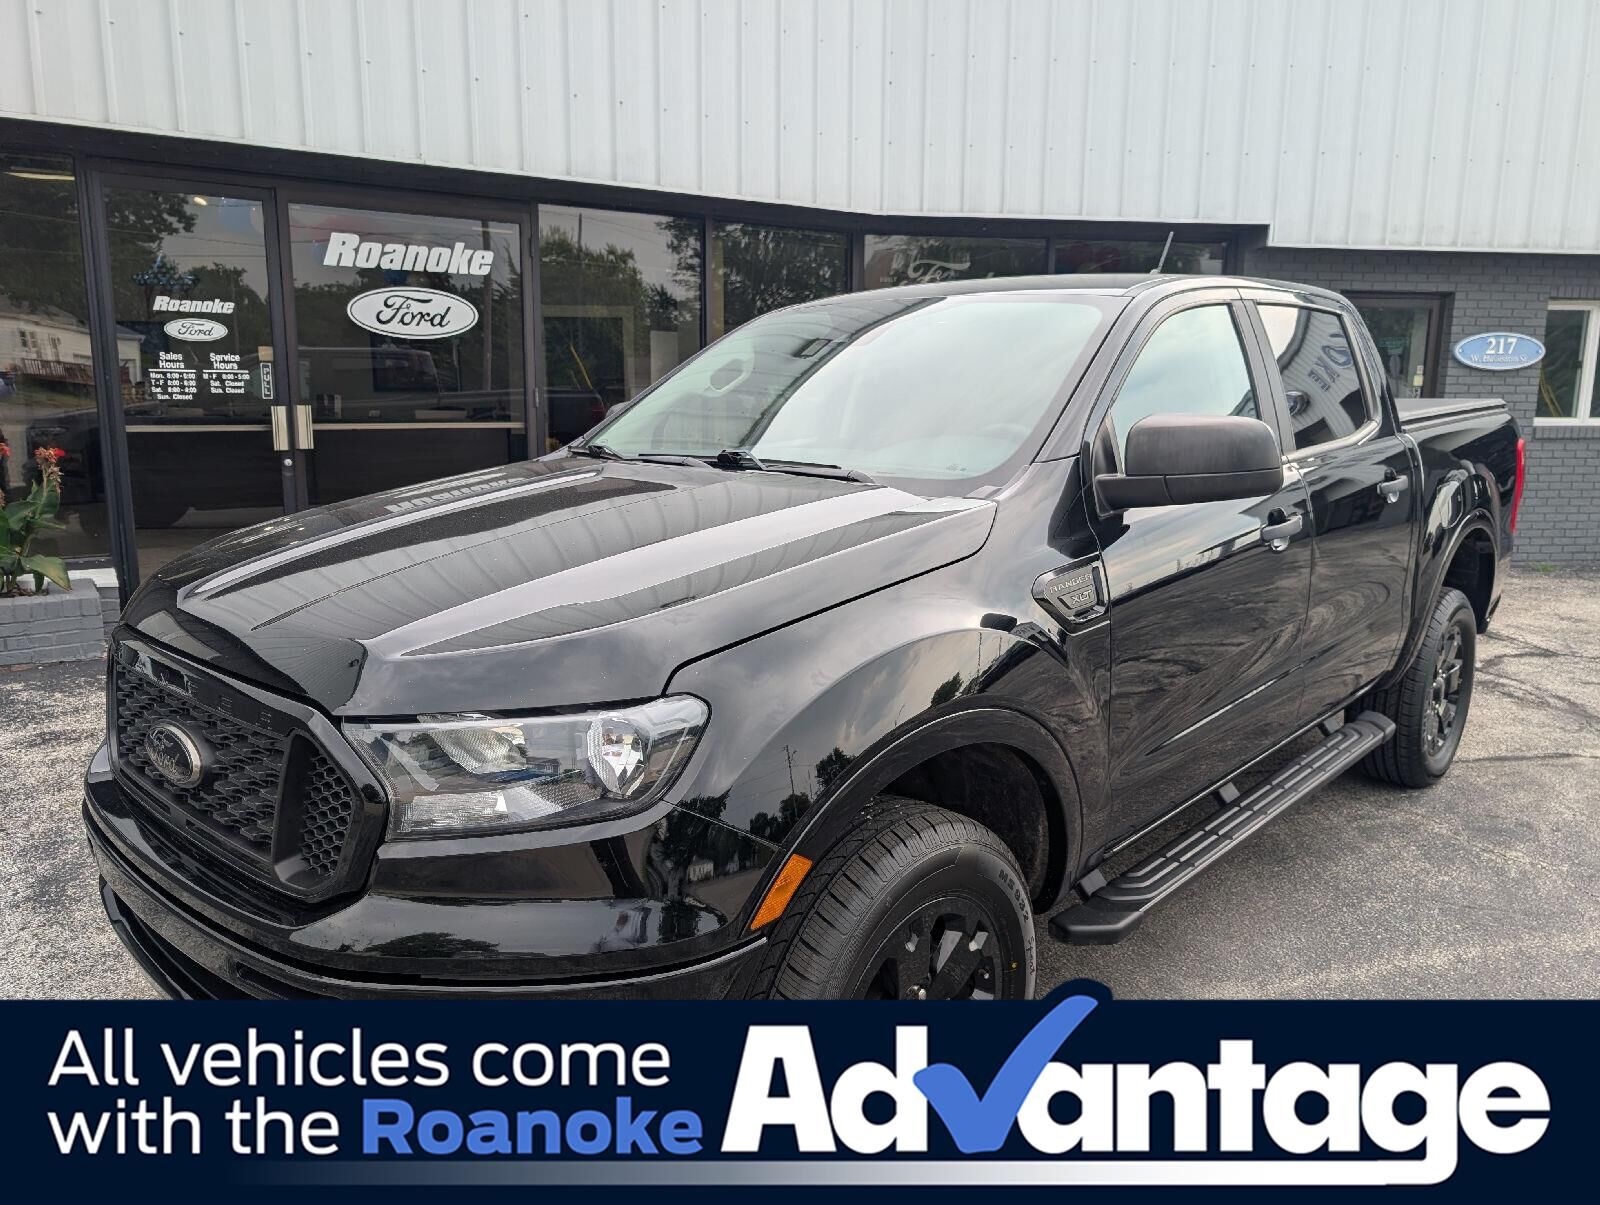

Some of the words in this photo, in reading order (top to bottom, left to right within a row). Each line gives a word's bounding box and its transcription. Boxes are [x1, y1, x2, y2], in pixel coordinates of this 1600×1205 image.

[323, 232, 495, 276] Roanoke
[153, 295, 235, 314] Roanoke
[376, 294, 452, 328] Ford
[178, 321, 214, 337] Ford
[1485, 337, 1518, 355] 217
[159, 352, 183, 361] Sales
[159, 360, 185, 369] Hours
[209, 352, 240, 362] Service
[213, 361, 238, 370] Hours
[263, 367, 271, 395] PULL
[1049, 573, 1092, 594] RANGER
[1070, 589, 1092, 605] XLT
